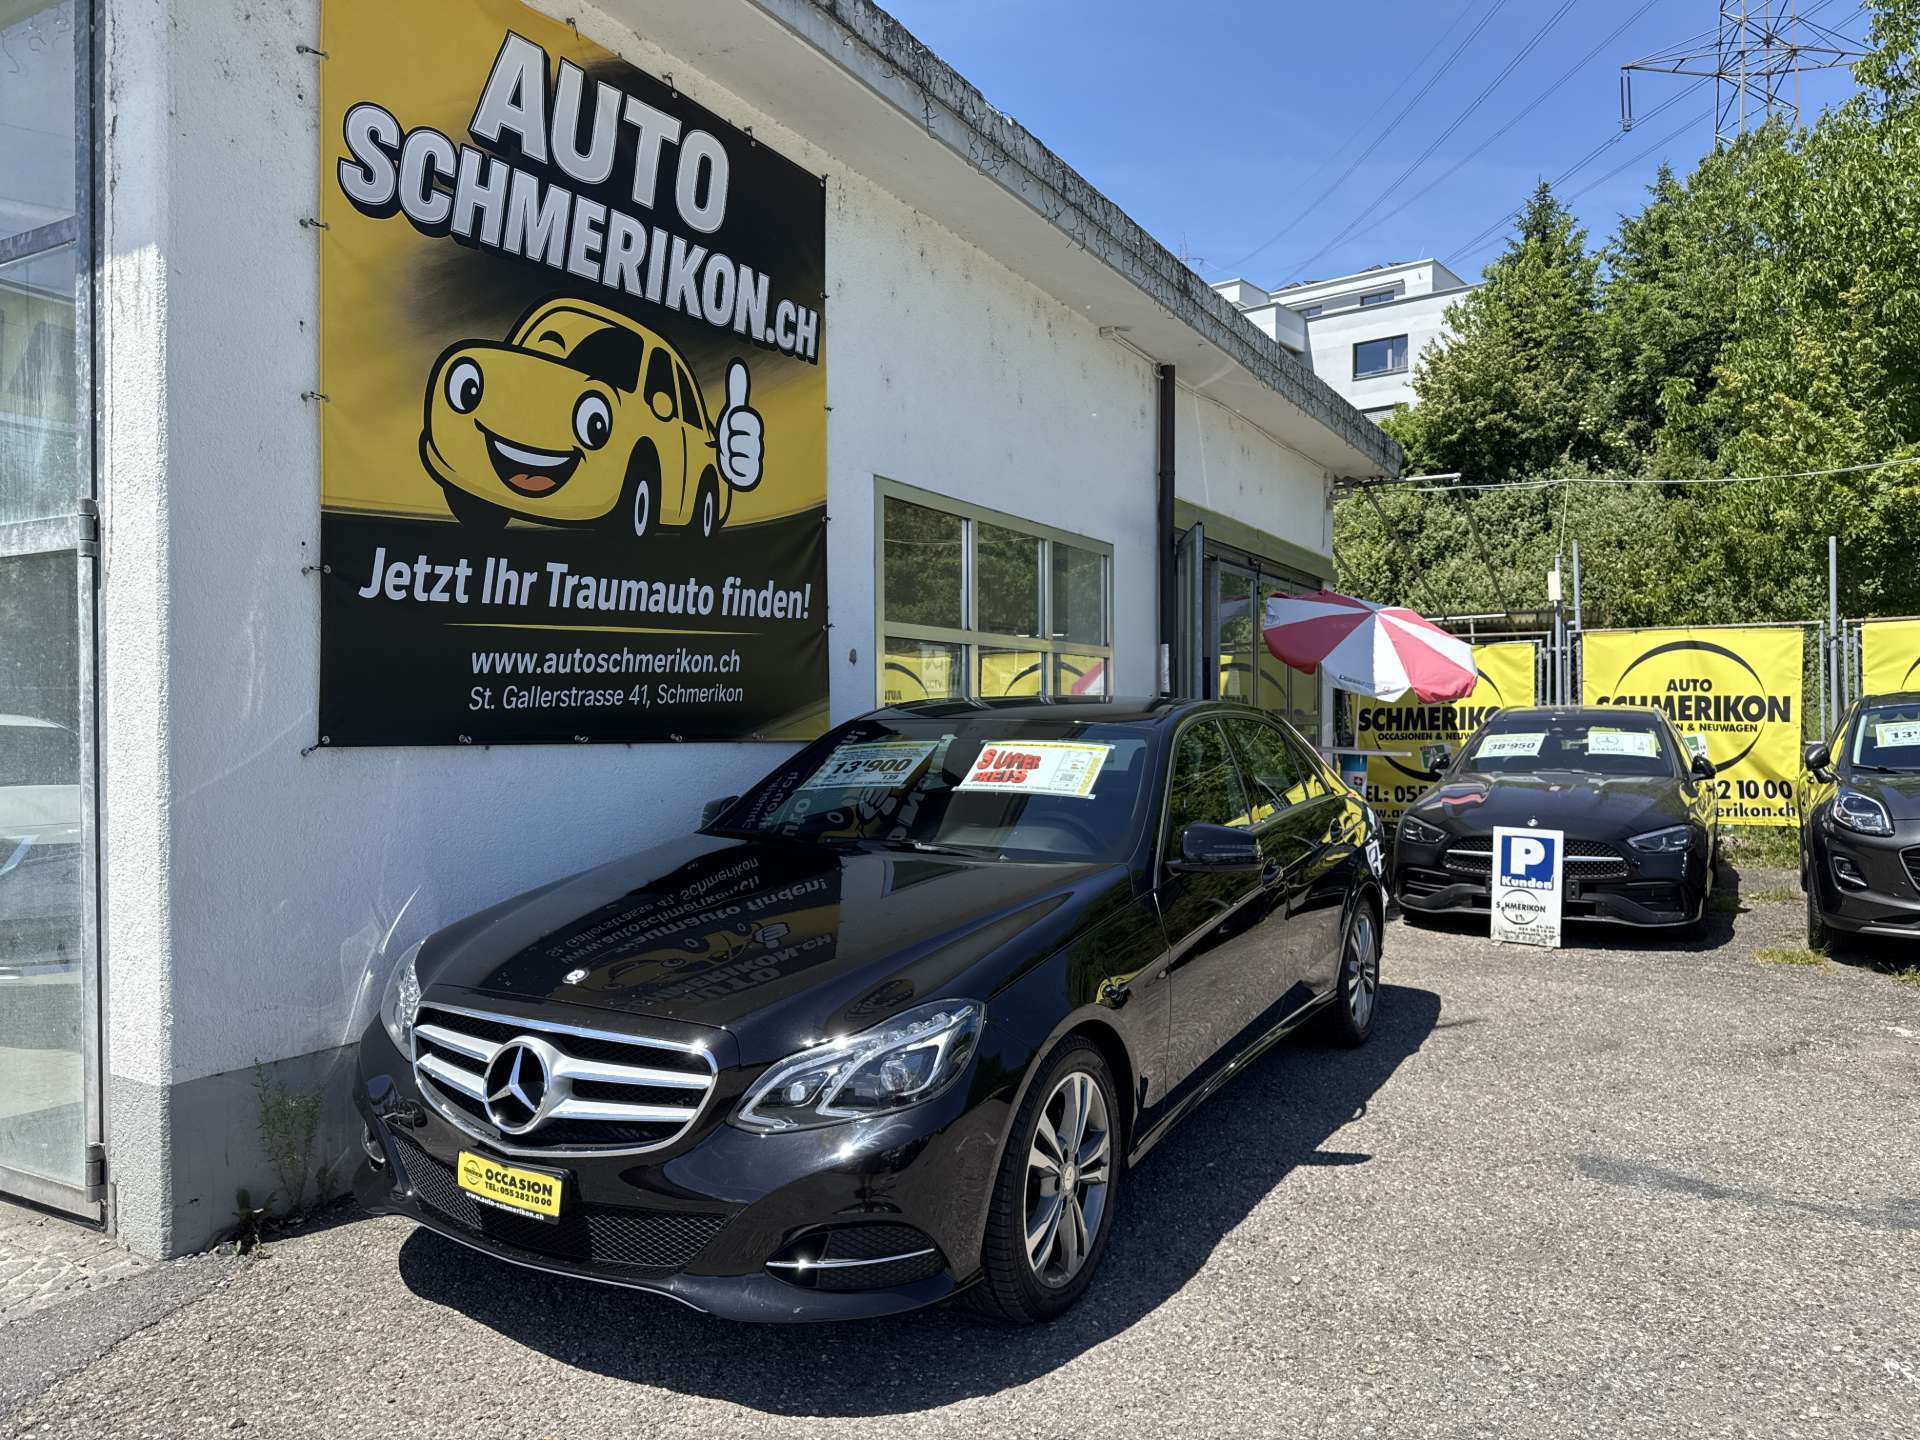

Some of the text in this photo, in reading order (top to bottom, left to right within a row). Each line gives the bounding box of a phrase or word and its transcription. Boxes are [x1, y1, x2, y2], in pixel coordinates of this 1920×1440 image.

[469, 29, 730, 234] AUTO
[337, 101, 821, 364] SCHMERIKON.CH
[358, 547, 811, 619] Jetzt Ihr Traumauto finden!
[471, 646, 741, 675] www.autoschmerikon.ch
[468, 683, 744, 711] St. Gallerstrasse 41, Schmerikon
[1666, 678, 1713, 692] AUTO
[1378, 732, 1433, 741] OCCASIONEN
[1435, 732, 1443, 741] &
[1687, 723, 1695, 732] &
[1699, 723, 1758, 733] NEUWAGEN
[1488, 742, 1536, 751] 38'950
[832, 758, 913, 775] 13'900
[1736, 780, 1760, 800] 10
[1763, 779, 1793, 800] 00
[1510, 836, 1546, 876] P
[1501, 875, 1554, 890] Kunden
[484, 1181, 500, 1193] TEL:
[500, 1187, 514, 1197] 055
[485, 1168, 553, 1197] OCCASION
[465, 1190, 545, 1221] www.auto-schmerikon.ch
